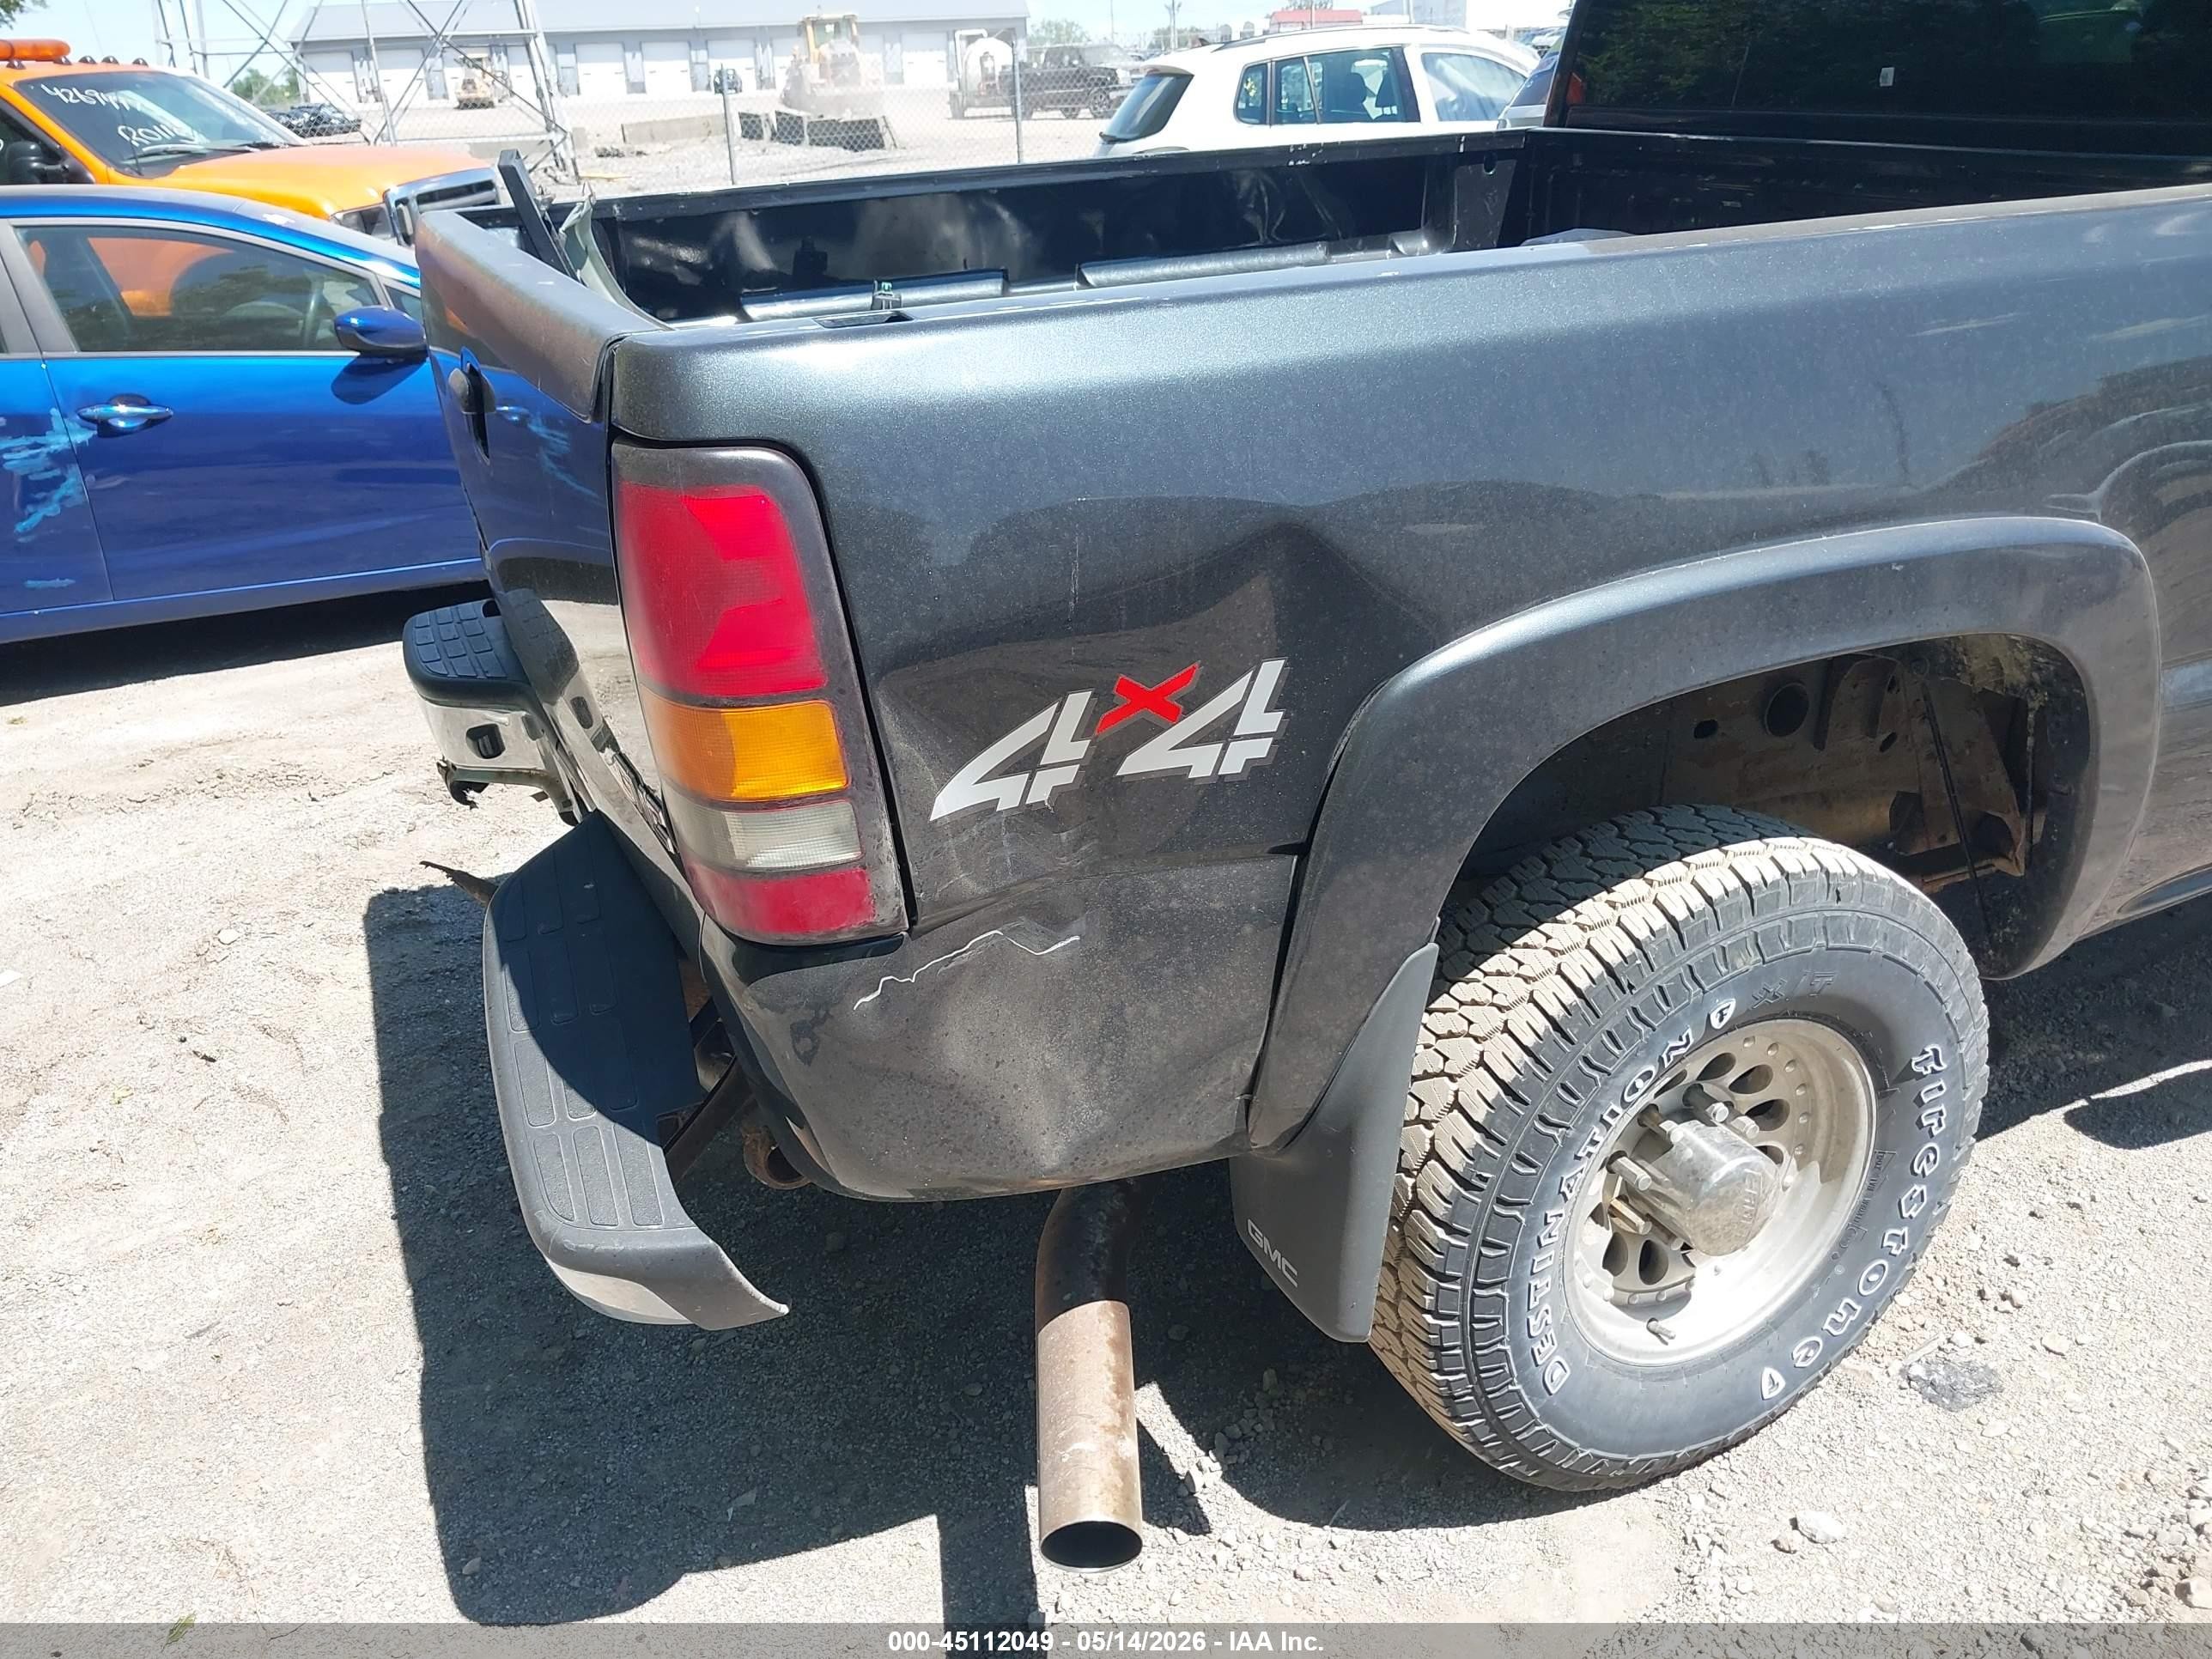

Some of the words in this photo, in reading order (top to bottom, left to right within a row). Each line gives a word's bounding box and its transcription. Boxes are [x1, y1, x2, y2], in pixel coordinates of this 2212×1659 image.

[1247, 1218, 1298, 1288] GMC
[1526, 1028, 1695, 1395] DESTINATION
[1791, 1043, 1945, 1370] Firestone
